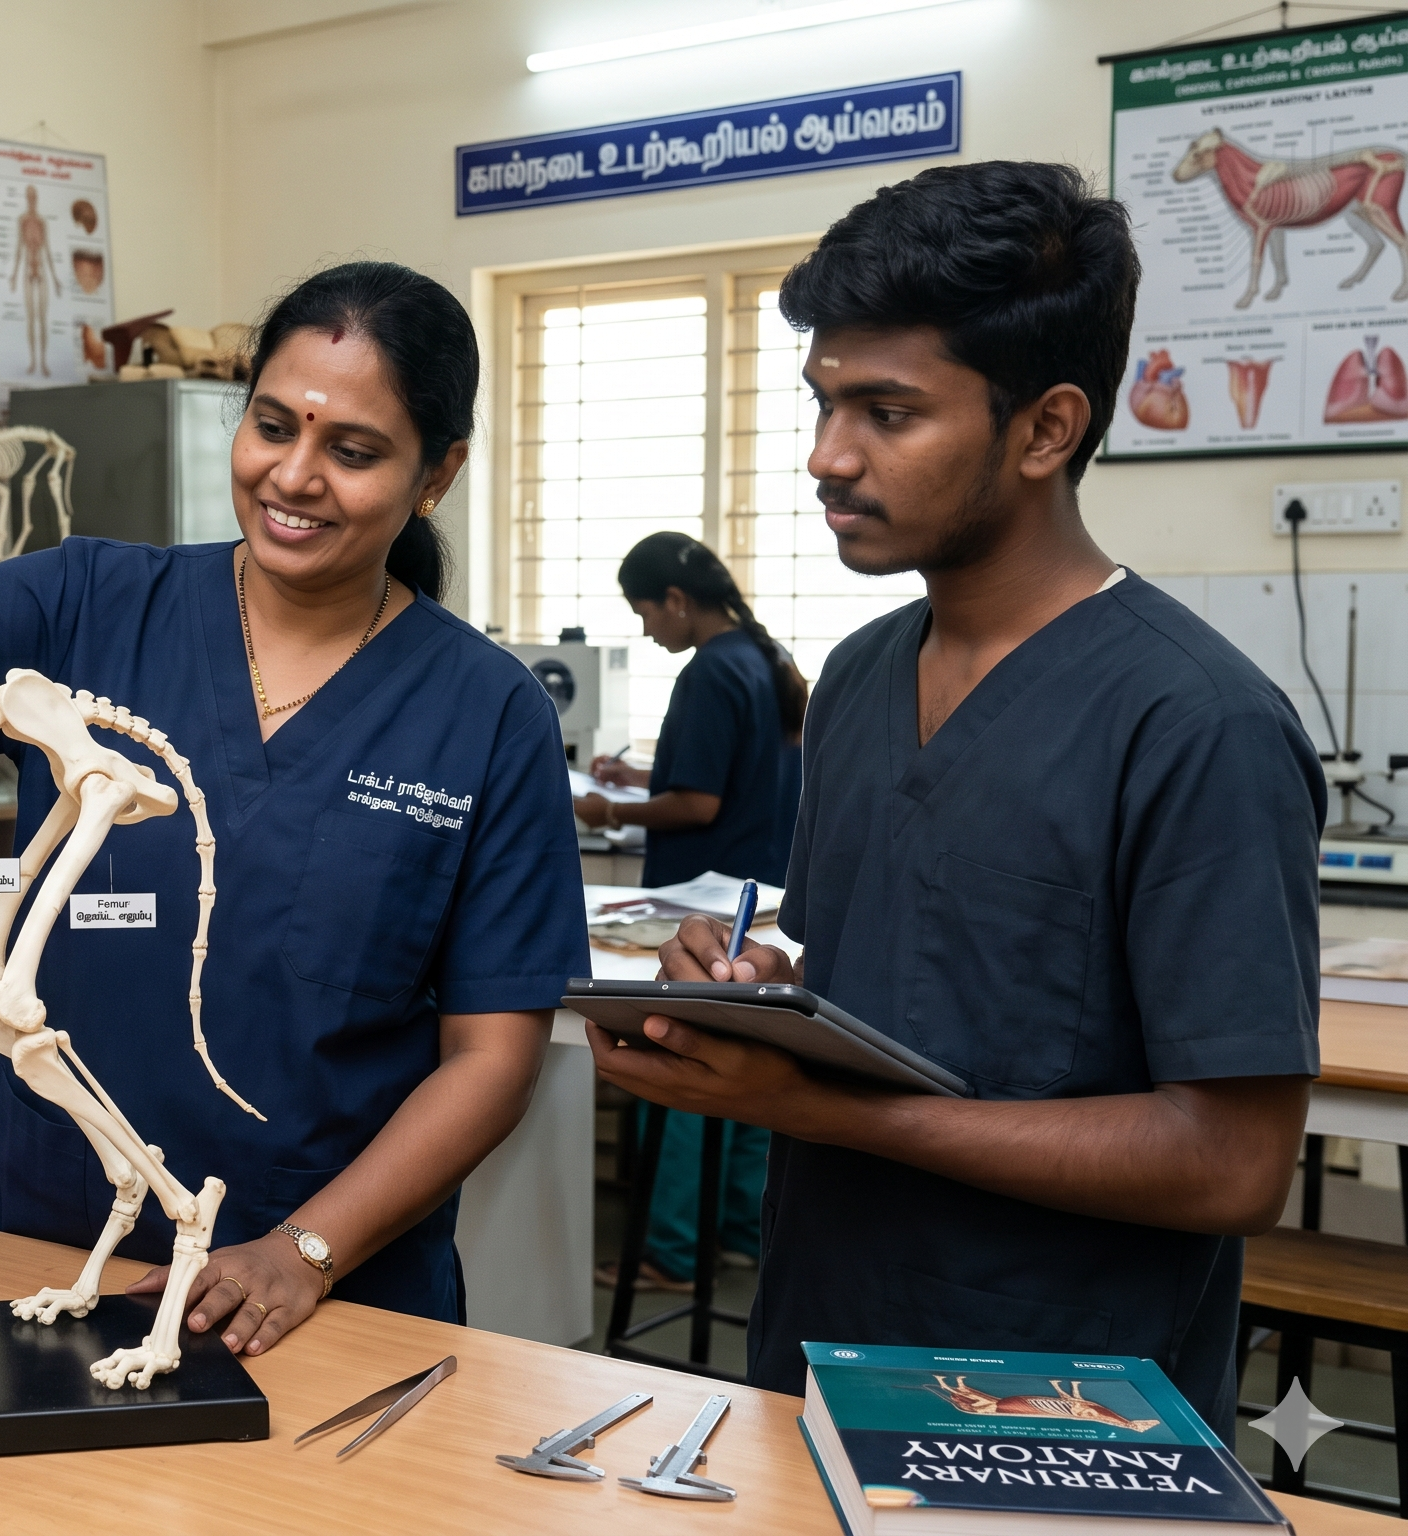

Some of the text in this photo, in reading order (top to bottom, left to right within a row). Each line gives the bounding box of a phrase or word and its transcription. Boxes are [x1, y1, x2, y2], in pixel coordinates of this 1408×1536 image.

[467, 89, 946, 196] கால்நடை உடற்கூறியல் ஆய்வகம்
[348, 769, 395, 791] டாக்டர்
[98, 899, 129, 908] Femur
[902, 1440, 1183, 1471] ANATOMY
[902, 1463, 1223, 1494] VETERINARY
